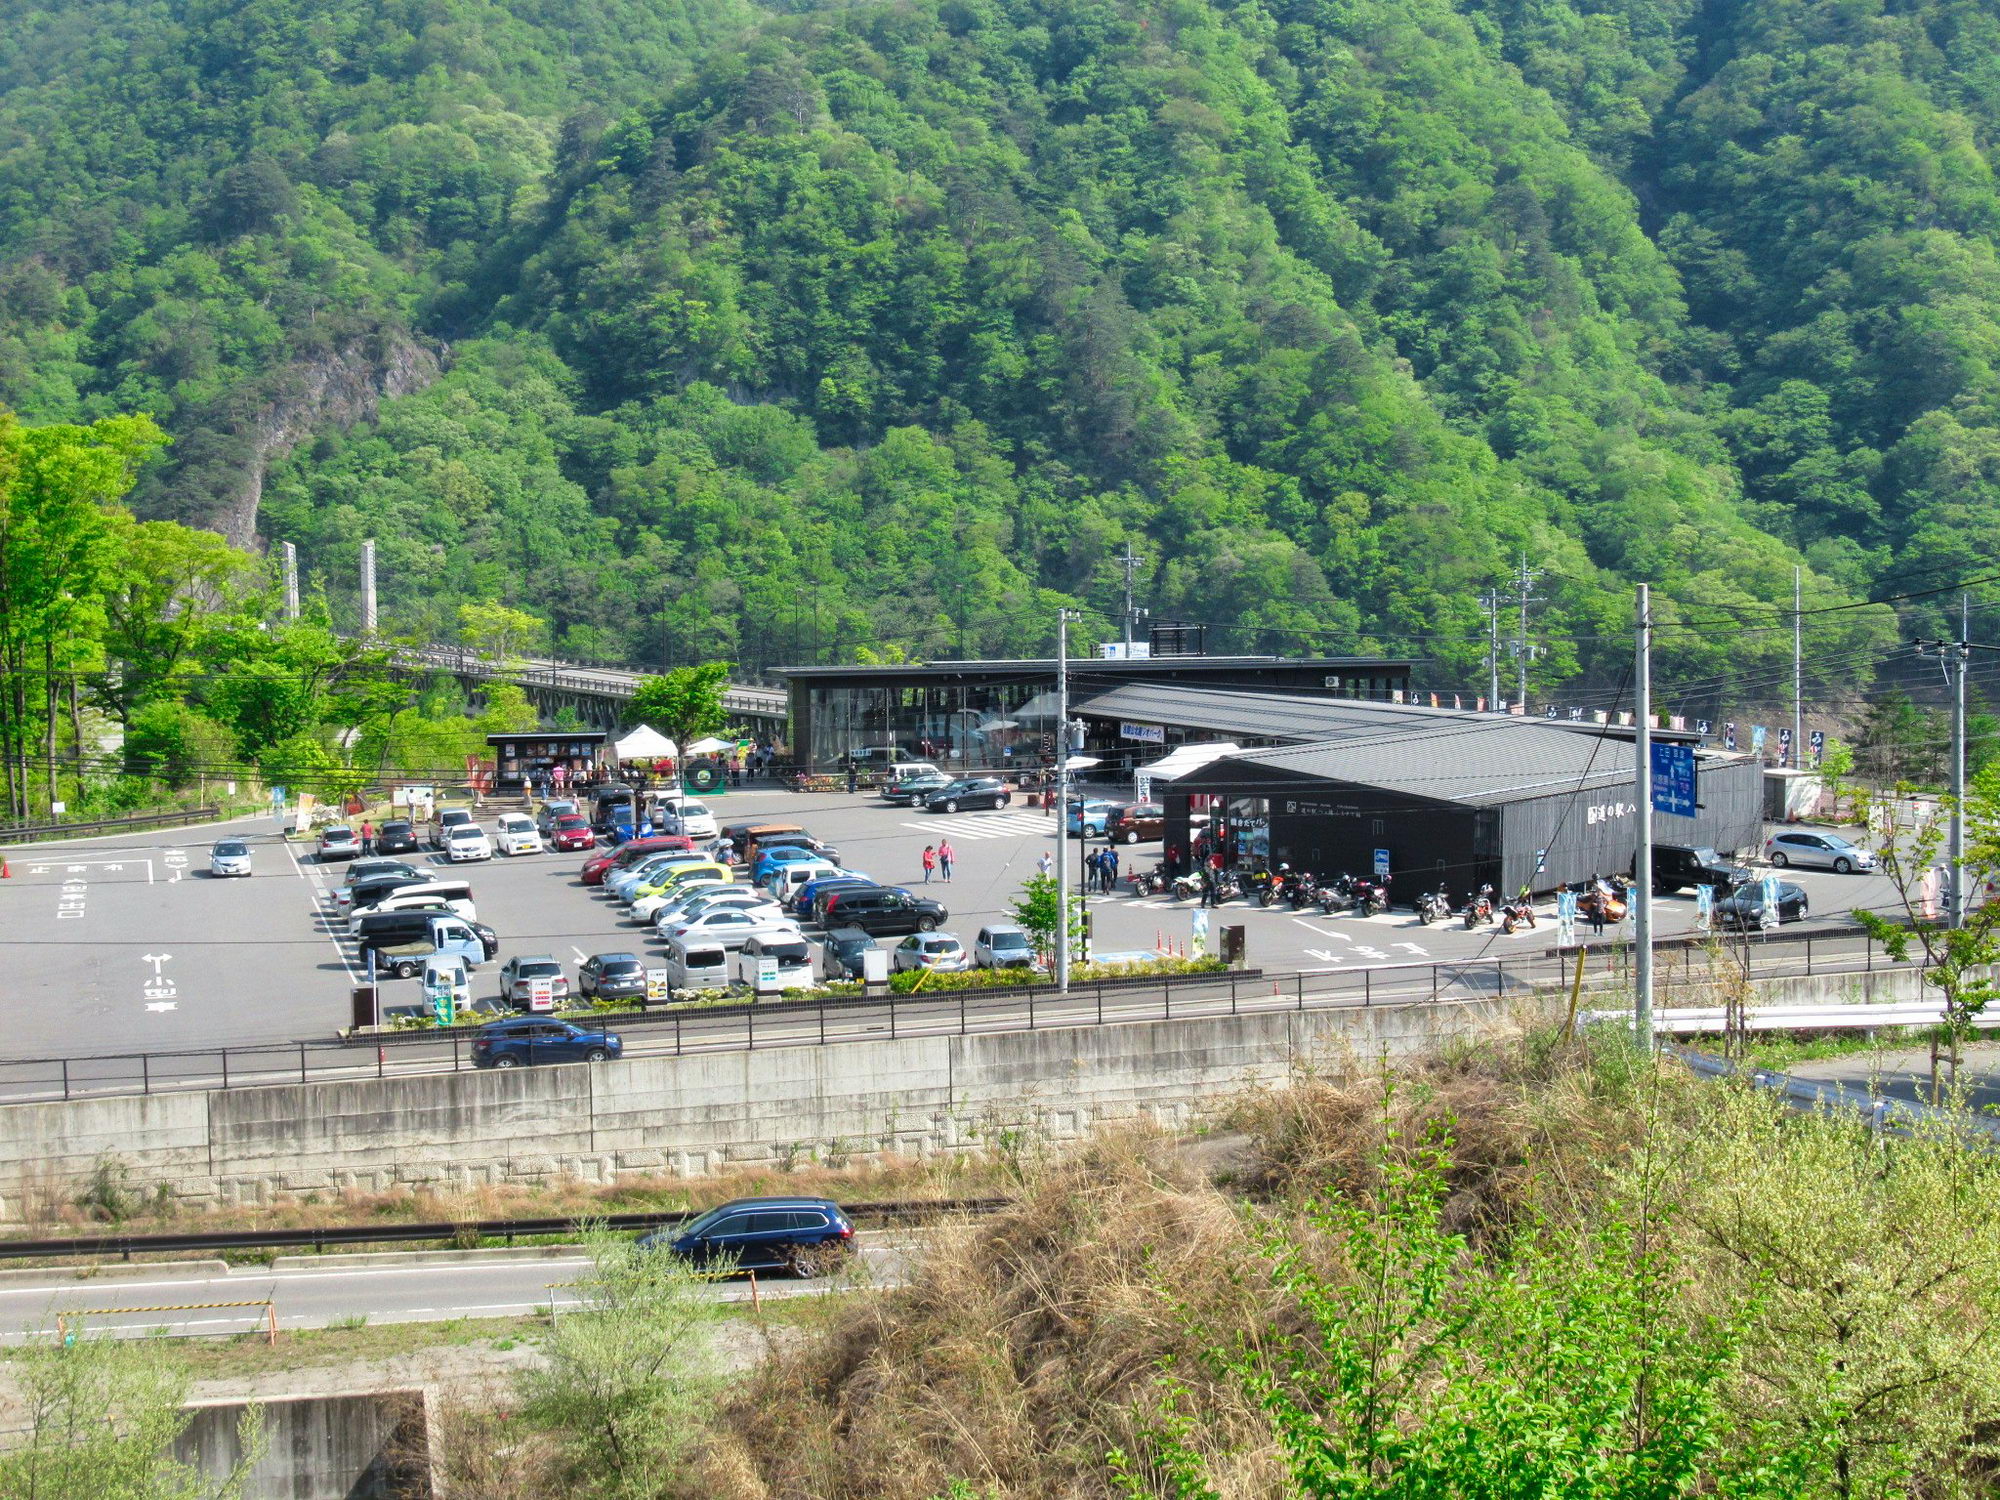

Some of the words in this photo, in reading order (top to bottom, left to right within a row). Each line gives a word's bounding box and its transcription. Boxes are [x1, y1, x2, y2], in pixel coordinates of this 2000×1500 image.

[1598, 801, 1654, 821] 道の駅八
[143, 976, 179, 1013] 小型車
